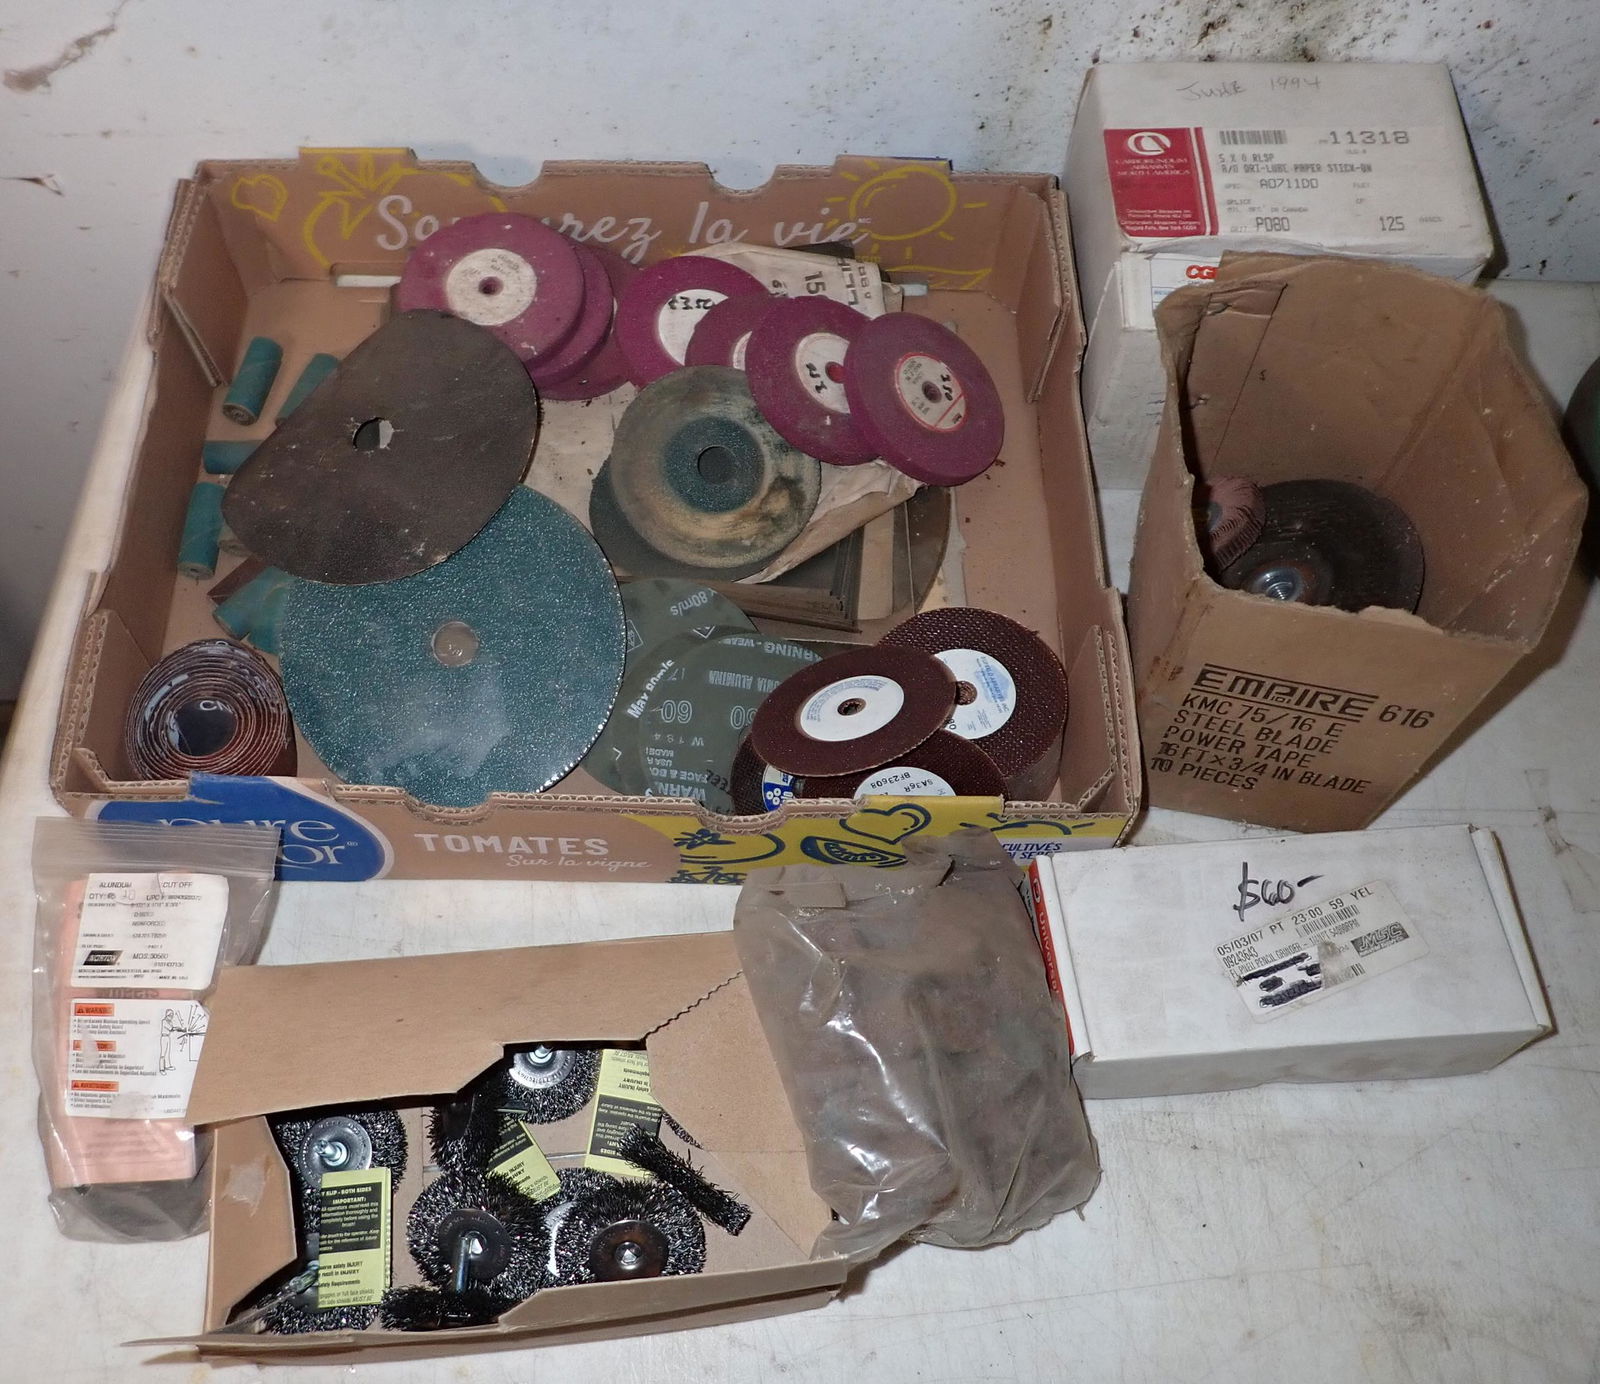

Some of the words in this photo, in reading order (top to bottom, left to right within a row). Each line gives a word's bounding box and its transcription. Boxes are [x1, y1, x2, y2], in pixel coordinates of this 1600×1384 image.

[1270, 76, 1321, 91] 1994
[1329, 130, 1410, 145] 11318
[689, 201, 749, 244] la
[1378, 216, 1405, 231] 125
[660, 700, 693, 724] 60
[1193, 668, 1376, 719] EMPIRE
[1379, 703, 1435, 730] 616
[1174, 709, 1246, 738] STEEL
[1255, 726, 1339, 755] BLADE
[1181, 693, 1235, 717] KMC
[1237, 704, 1316, 732] 75/16
[1325, 722, 1347, 739] E
[1163, 725, 1247, 755] POWER
[1256, 744, 1317, 769] TAPE
[1178, 762, 1259, 791] PIECES
[1228, 757, 1269, 776] 3/4
[1271, 766, 1296, 782] IN
[1298, 770, 1373, 795] BLADE
[413, 833, 609, 856] TOMATES
[505, 854, 553, 868] Sur
[557, 855, 584, 867] la
[586, 856, 653, 873] vigne
[1216, 930, 1265, 957] 05/03/07
[1269, 922, 1286, 935] PT
[1291, 906, 1324, 926] 23:00
[1329, 897, 1346, 910] 59
[1350, 886, 1375, 901] YEL
